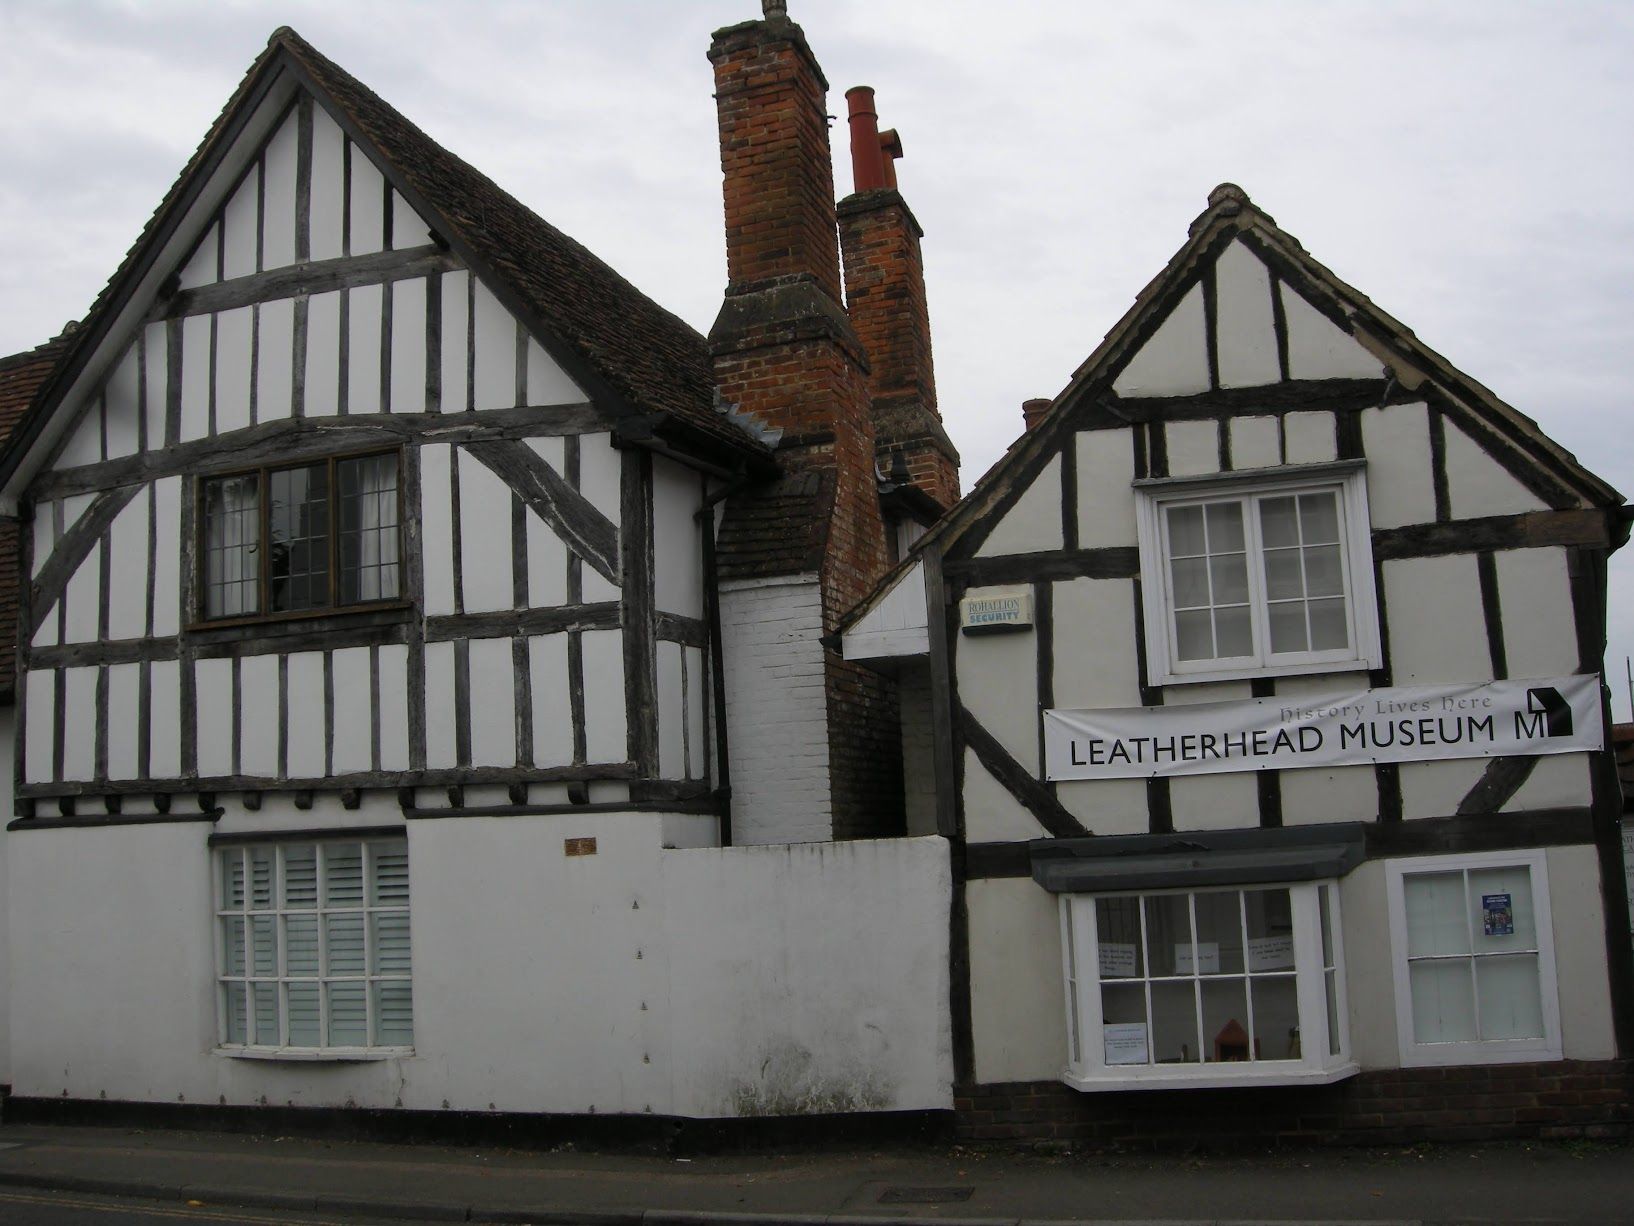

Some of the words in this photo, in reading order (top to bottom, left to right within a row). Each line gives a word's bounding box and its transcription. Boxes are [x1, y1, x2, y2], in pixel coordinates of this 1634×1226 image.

[969, 612, 1018, 623] SECURITY
[1280, 704, 1365, 722] History
[1375, 699, 1430, 715] Lives
[1441, 695, 1492, 712] Here
[1070, 726, 1323, 766] LEATHERHEAD
[1340, 715, 1494, 750] MUSEUM
